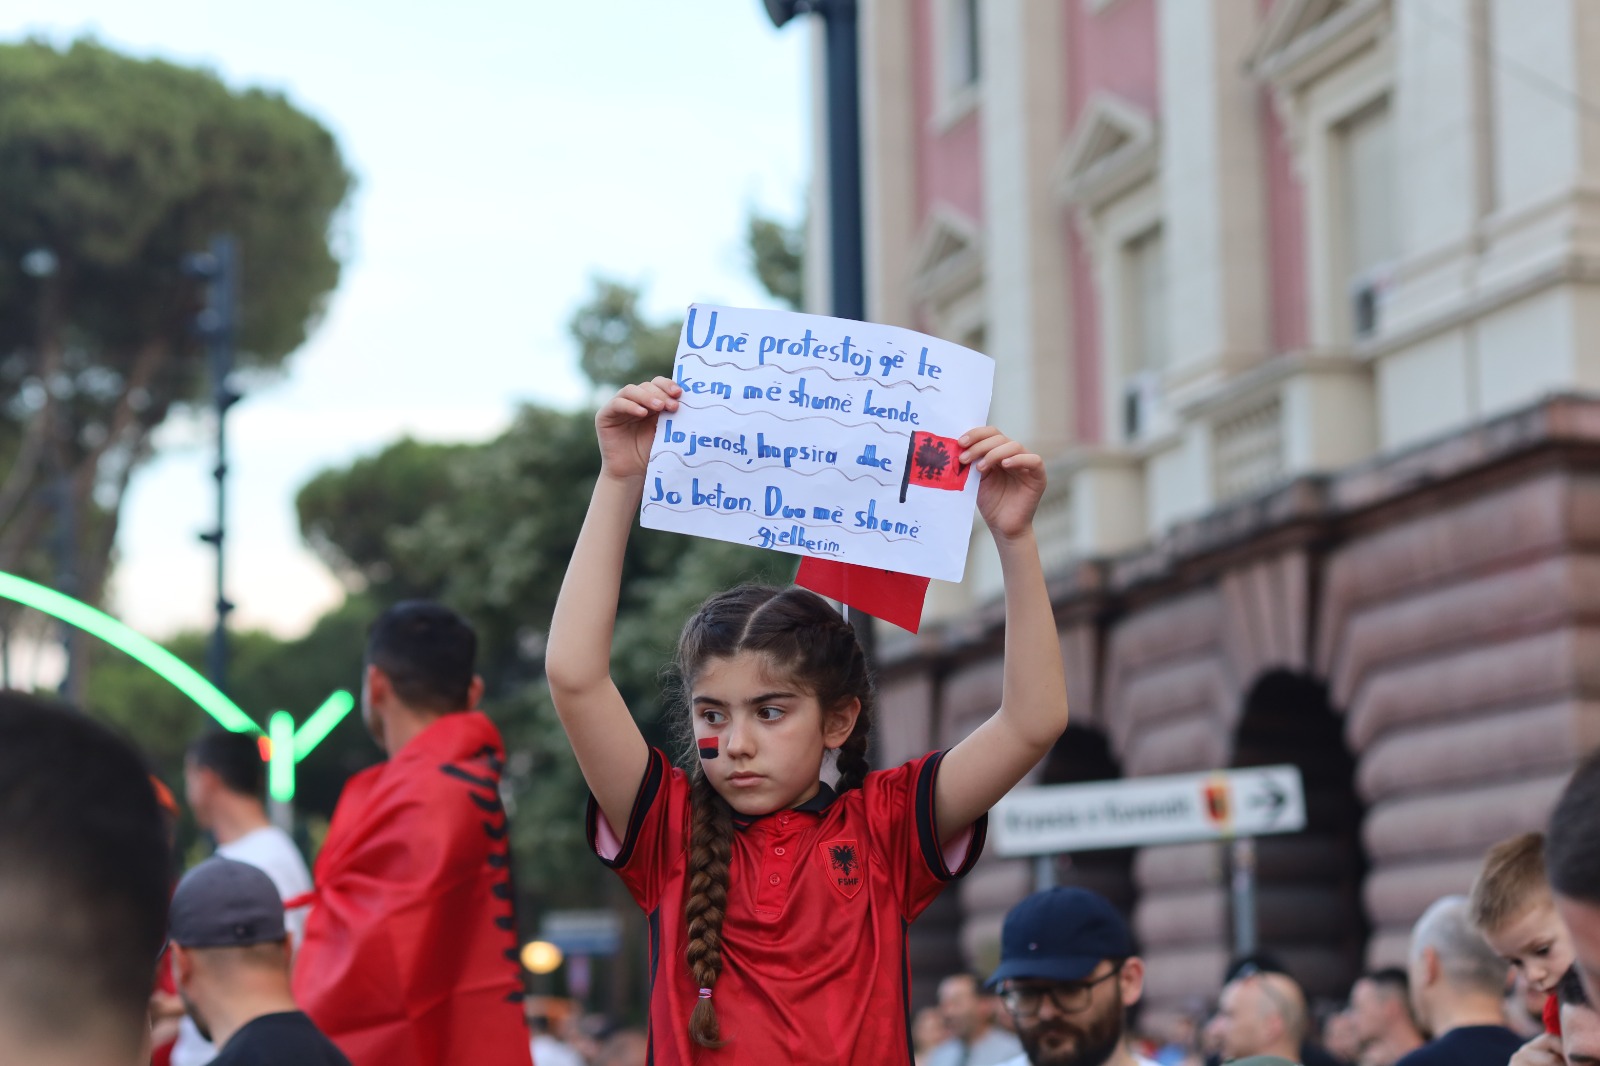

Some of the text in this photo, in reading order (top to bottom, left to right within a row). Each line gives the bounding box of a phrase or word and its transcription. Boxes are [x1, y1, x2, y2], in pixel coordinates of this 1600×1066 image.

[758, 329, 873, 377] protestoj
[676, 364, 732, 399] kem
[743, 381, 782, 401] më
[862, 389, 920, 426] kende
[691, 477, 757, 512] beton.
[837, 877, 859, 886] FSHF
